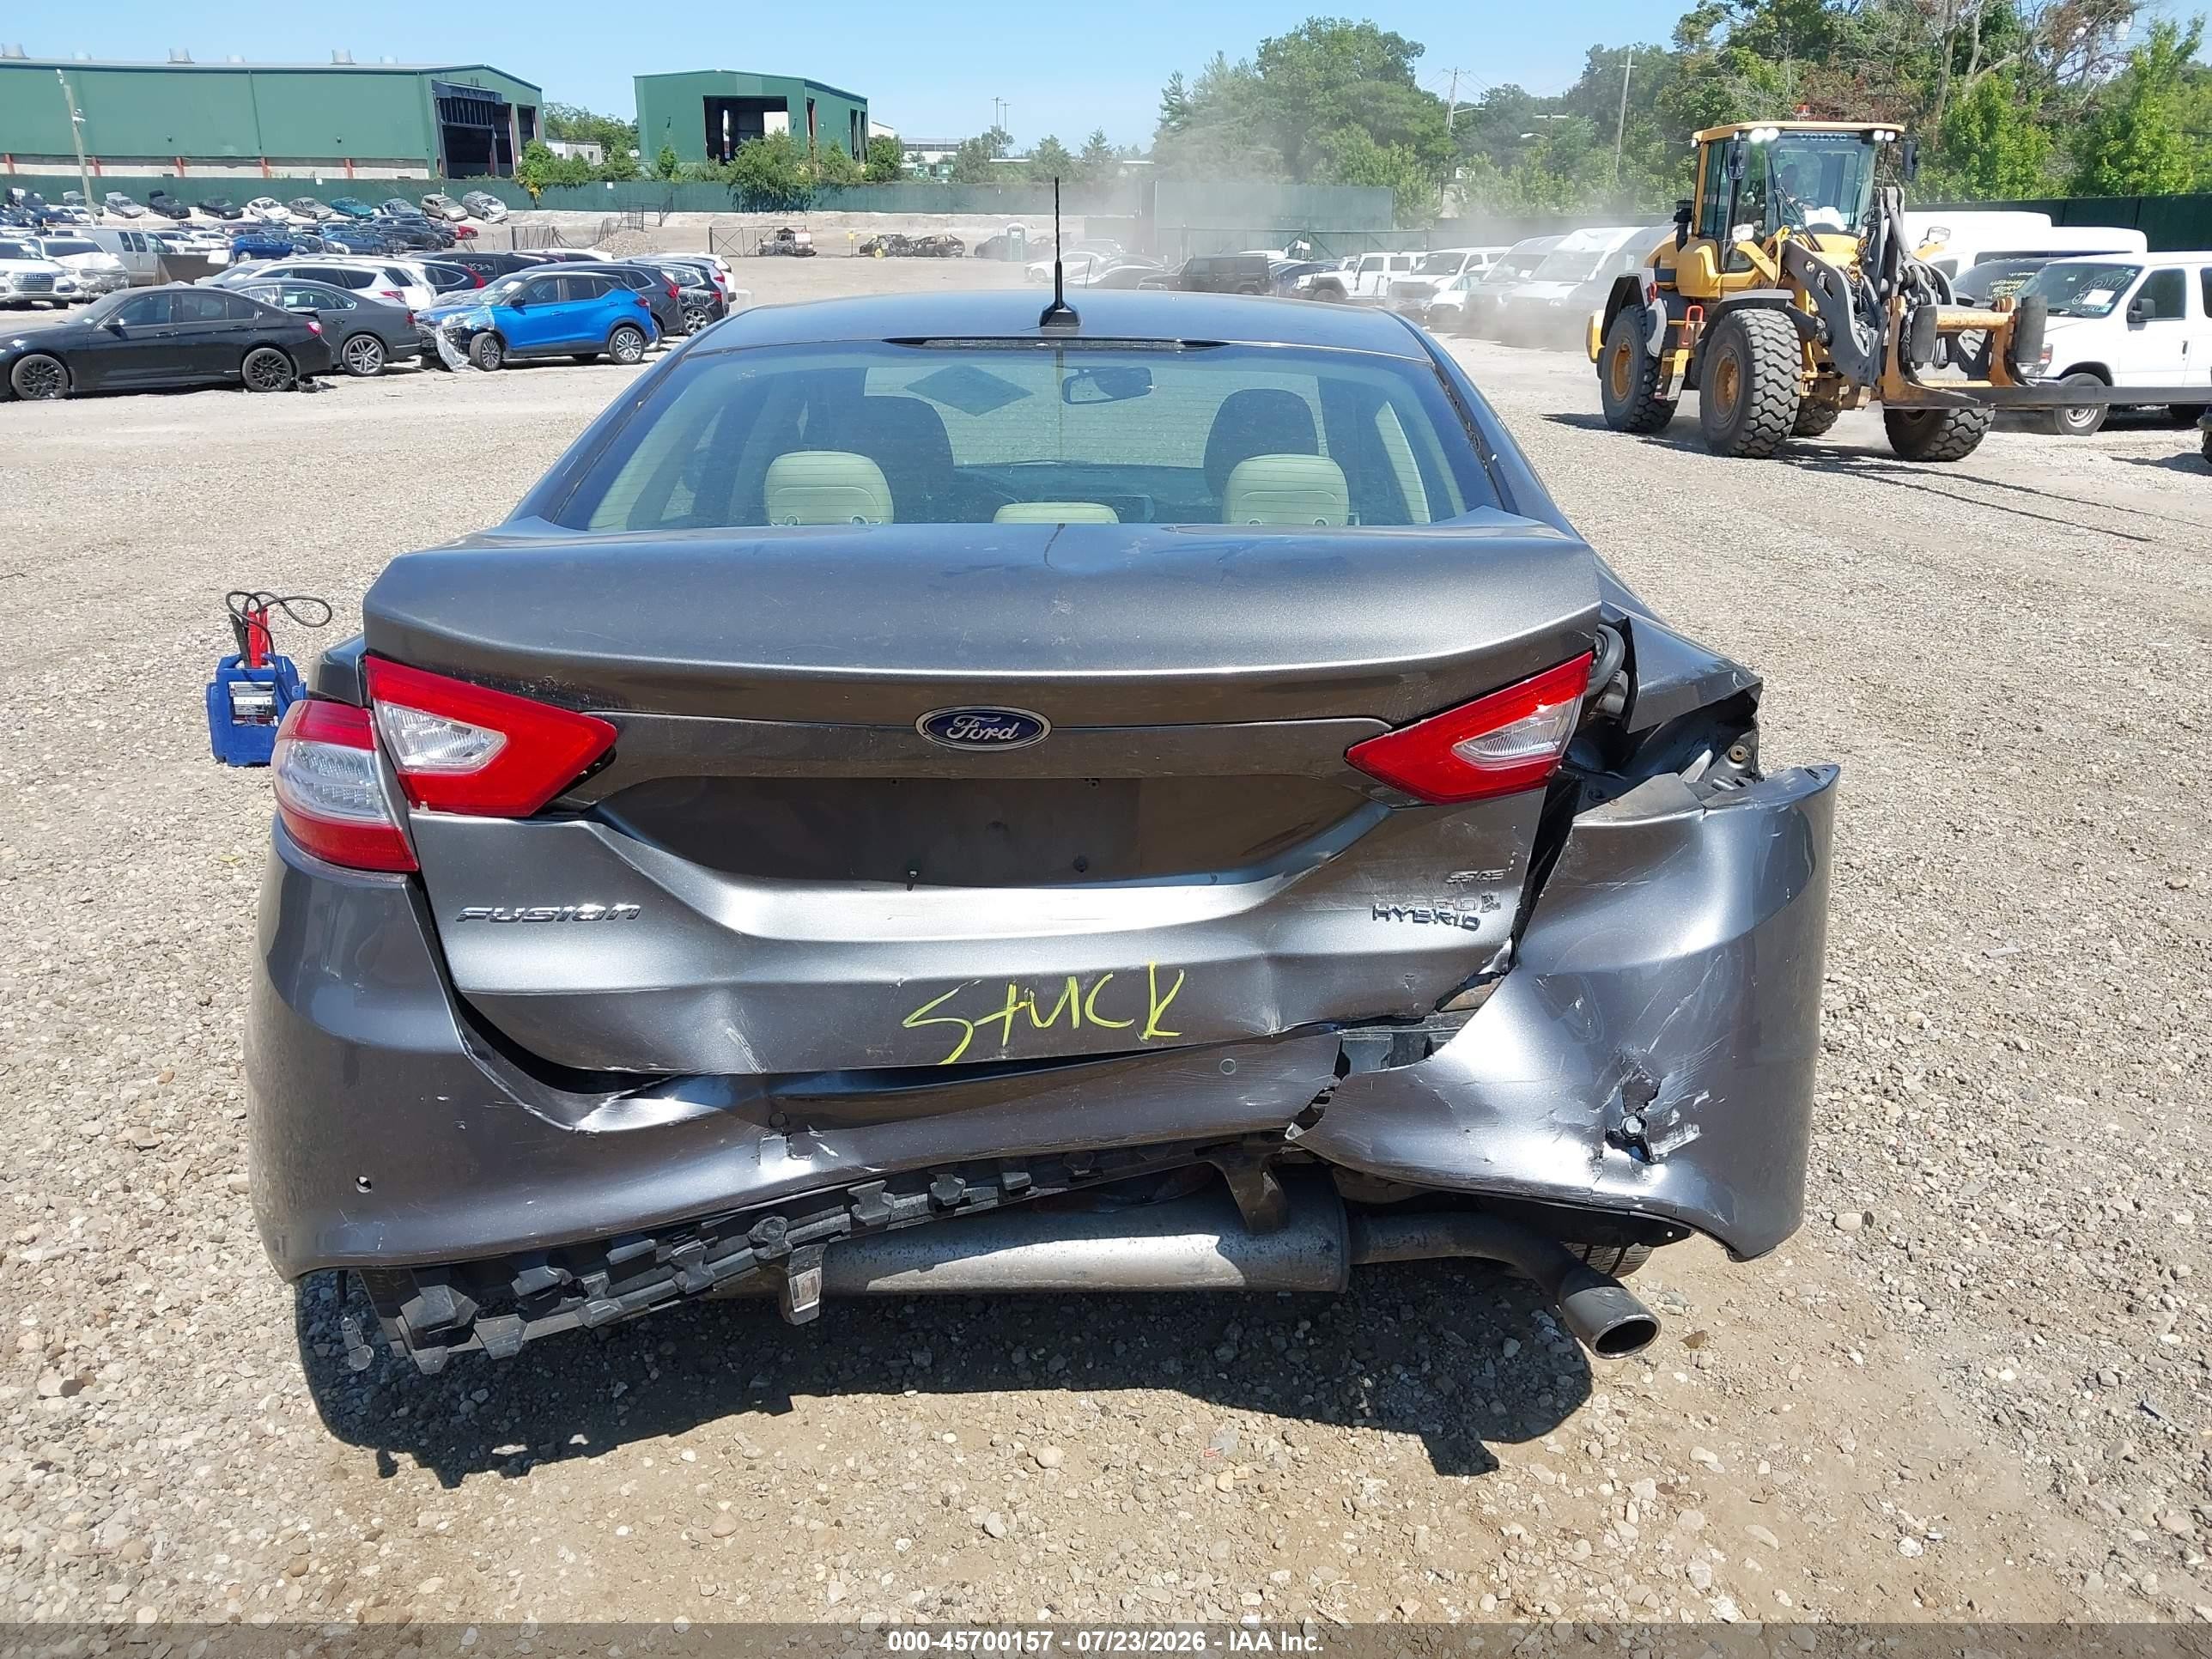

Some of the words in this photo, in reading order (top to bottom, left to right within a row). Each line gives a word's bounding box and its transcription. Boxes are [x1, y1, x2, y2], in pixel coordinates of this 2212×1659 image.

[1796, 132, 1848, 142] VOLVO
[945, 714, 1021, 740] Ford
[1371, 902, 1481, 932] HYBRID
